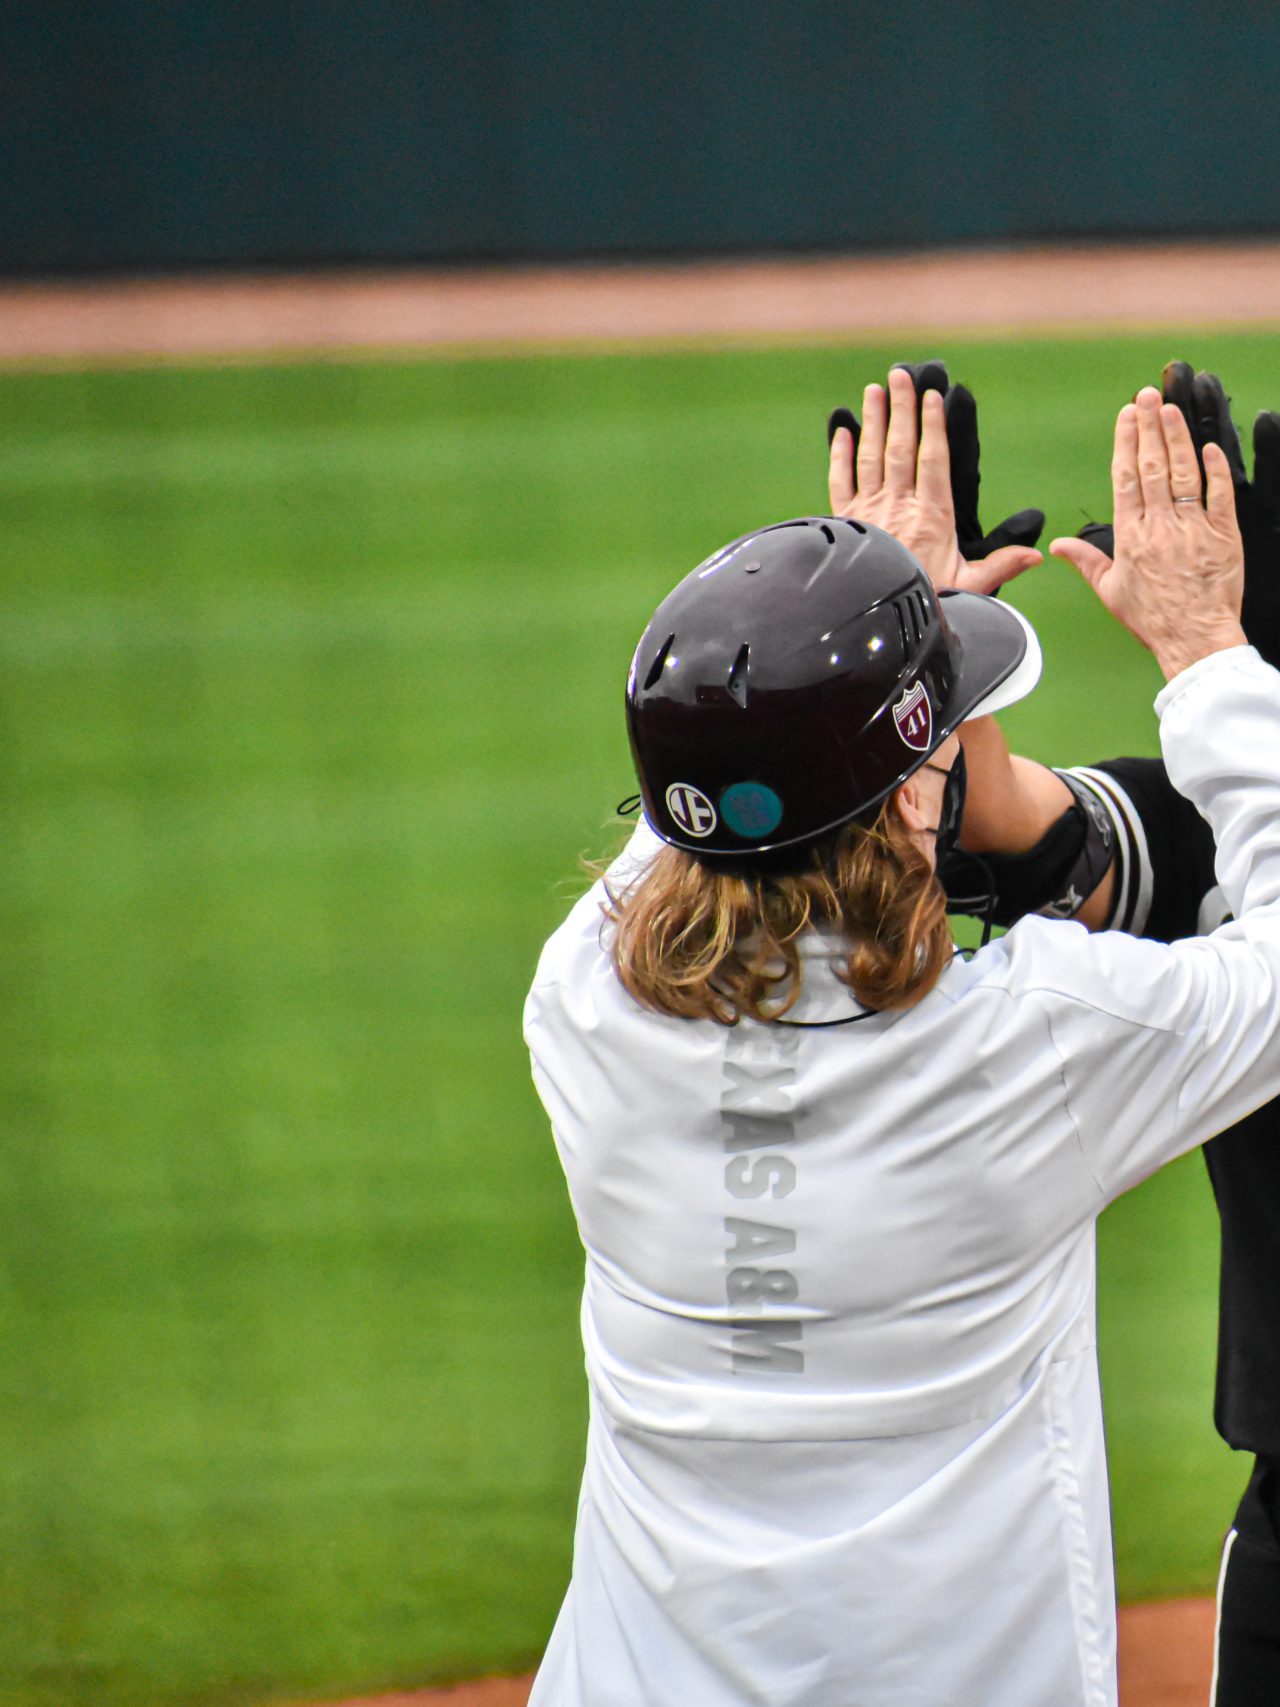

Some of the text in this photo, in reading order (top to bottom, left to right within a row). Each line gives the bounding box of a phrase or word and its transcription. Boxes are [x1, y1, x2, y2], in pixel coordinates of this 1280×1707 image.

[907, 706, 927, 737] 41
[721, 1025, 804, 1375] EXAS A&M
